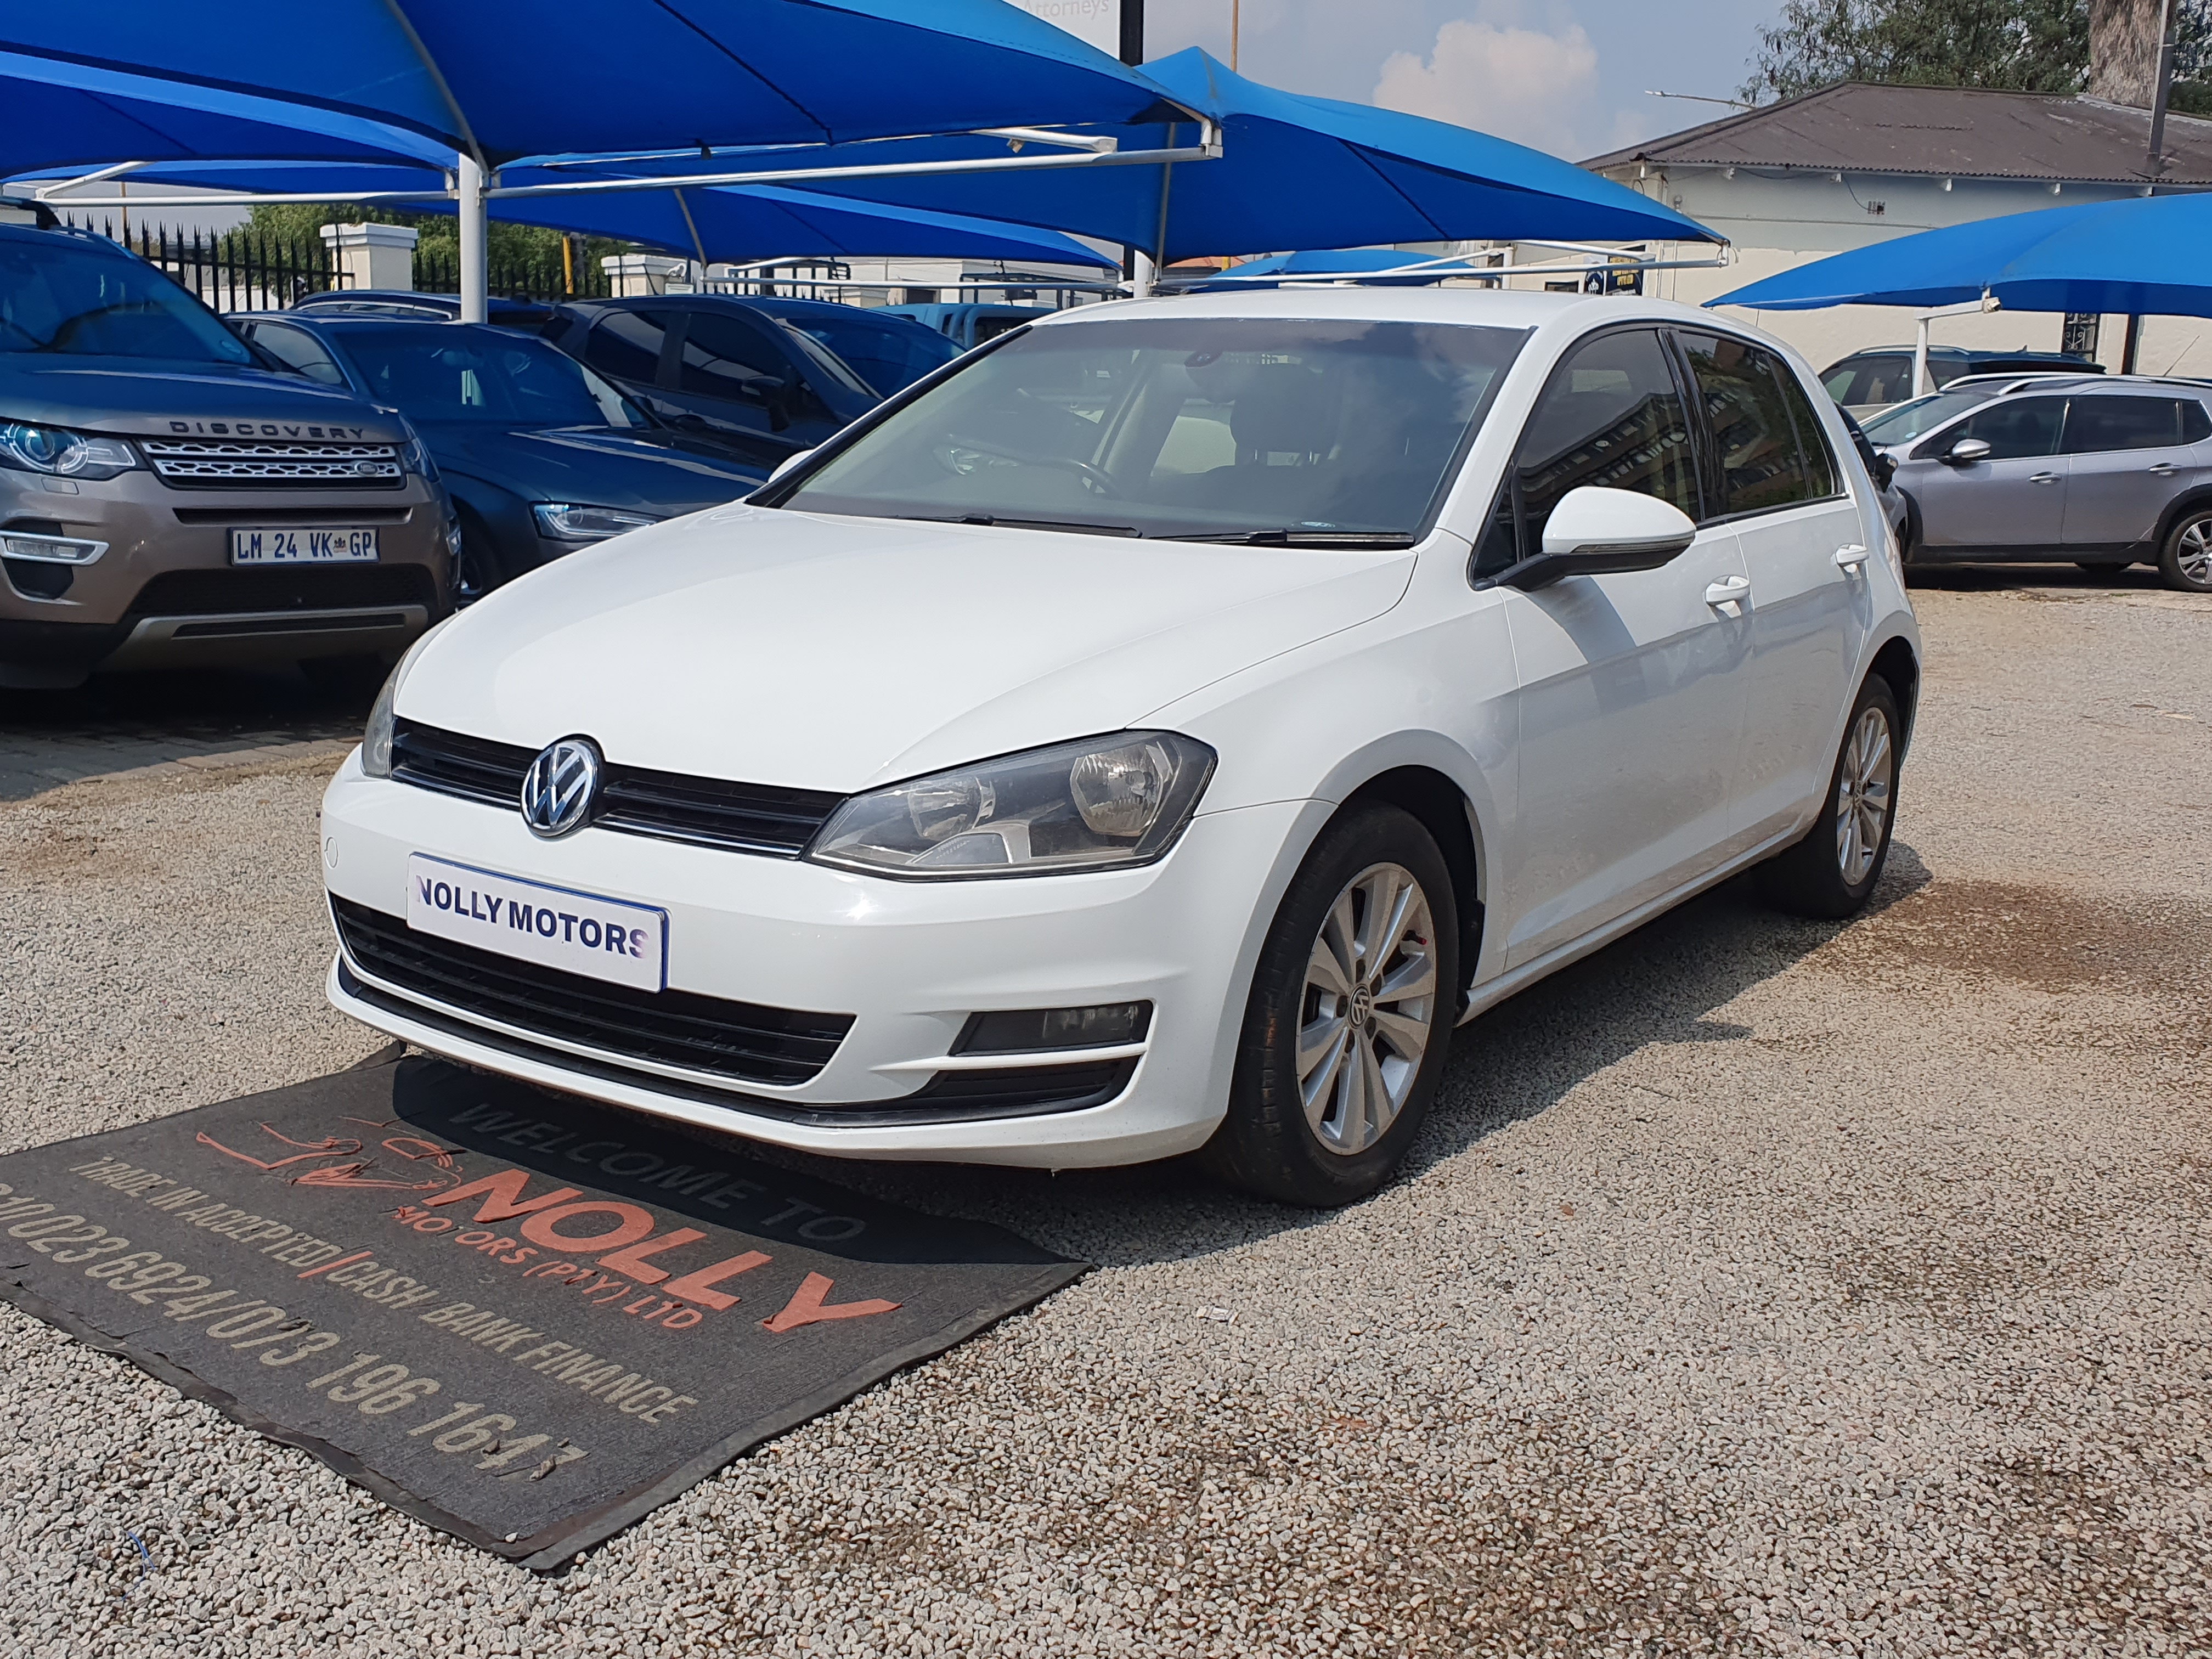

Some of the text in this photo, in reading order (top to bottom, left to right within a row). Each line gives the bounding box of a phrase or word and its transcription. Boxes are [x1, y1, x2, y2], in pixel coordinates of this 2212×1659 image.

[169, 421, 363, 439] DISCOVERY
[237, 532, 372, 559] LM 24 VK GP
[416, 874, 649, 959] NOLLY MOTORS
[448, 1103, 866, 1242] WELCOME TO
[69, 1156, 178, 1197] TRADE
[145, 1187, 210, 1211] IN
[417, 1302, 546, 1353] BANK
[513, 1340, 699, 1423] FINANCE
[392, 1205, 539, 1263] MOORS
[622, 1295, 703, 1329] LTD
[422, 1169, 903, 1333] NOLLY
[305, 1351, 441, 1414] 196
